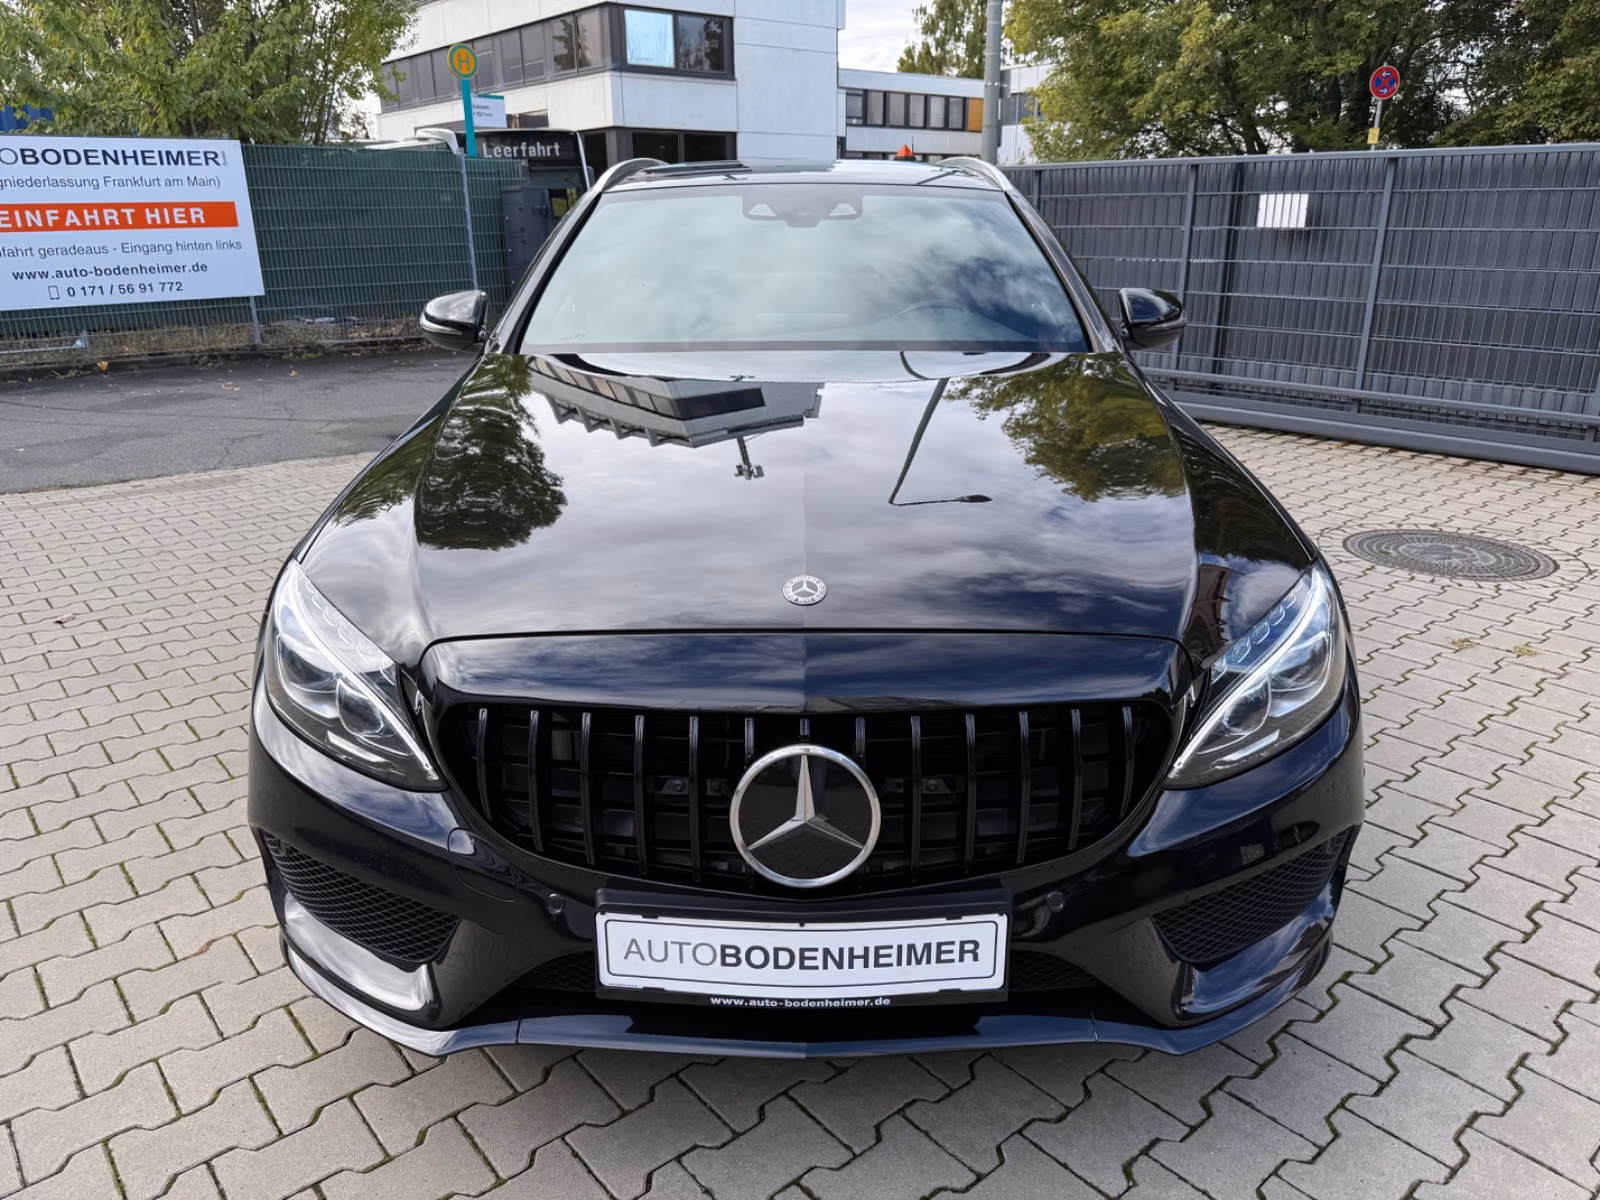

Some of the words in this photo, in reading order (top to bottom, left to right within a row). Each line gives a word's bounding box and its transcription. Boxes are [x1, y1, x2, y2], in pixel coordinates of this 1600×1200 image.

[0, 147, 221, 166] OBODENHEIMER
[482, 141, 560, 158] Leerfahrt
[103, 176, 161, 188] Frankfurt
[164, 178, 183, 188] am
[187, 176, 221, 189] Main)
[0, 208, 135, 228] EINFAHRT
[145, 207, 206, 225] HIER
[38, 243, 109, 260] geradeaus
[121, 242, 173, 255] Eingang
[176, 240, 212, 252] hinten
[216, 239, 242, 251] links
[12, 262, 208, 281] www.auto-bodenheimer.de
[66, 286, 76, 298] 0
[80, 285, 104, 297] 171
[109, 284, 115, 296] /
[118, 284, 135, 295] 56
[139, 283, 154, 294] 91
[158, 281, 184, 292] 772
[623, 938, 980, 971] AUTOBODENHEIMER
[710, 996, 891, 1009] www.auto-bodenheimer.de
